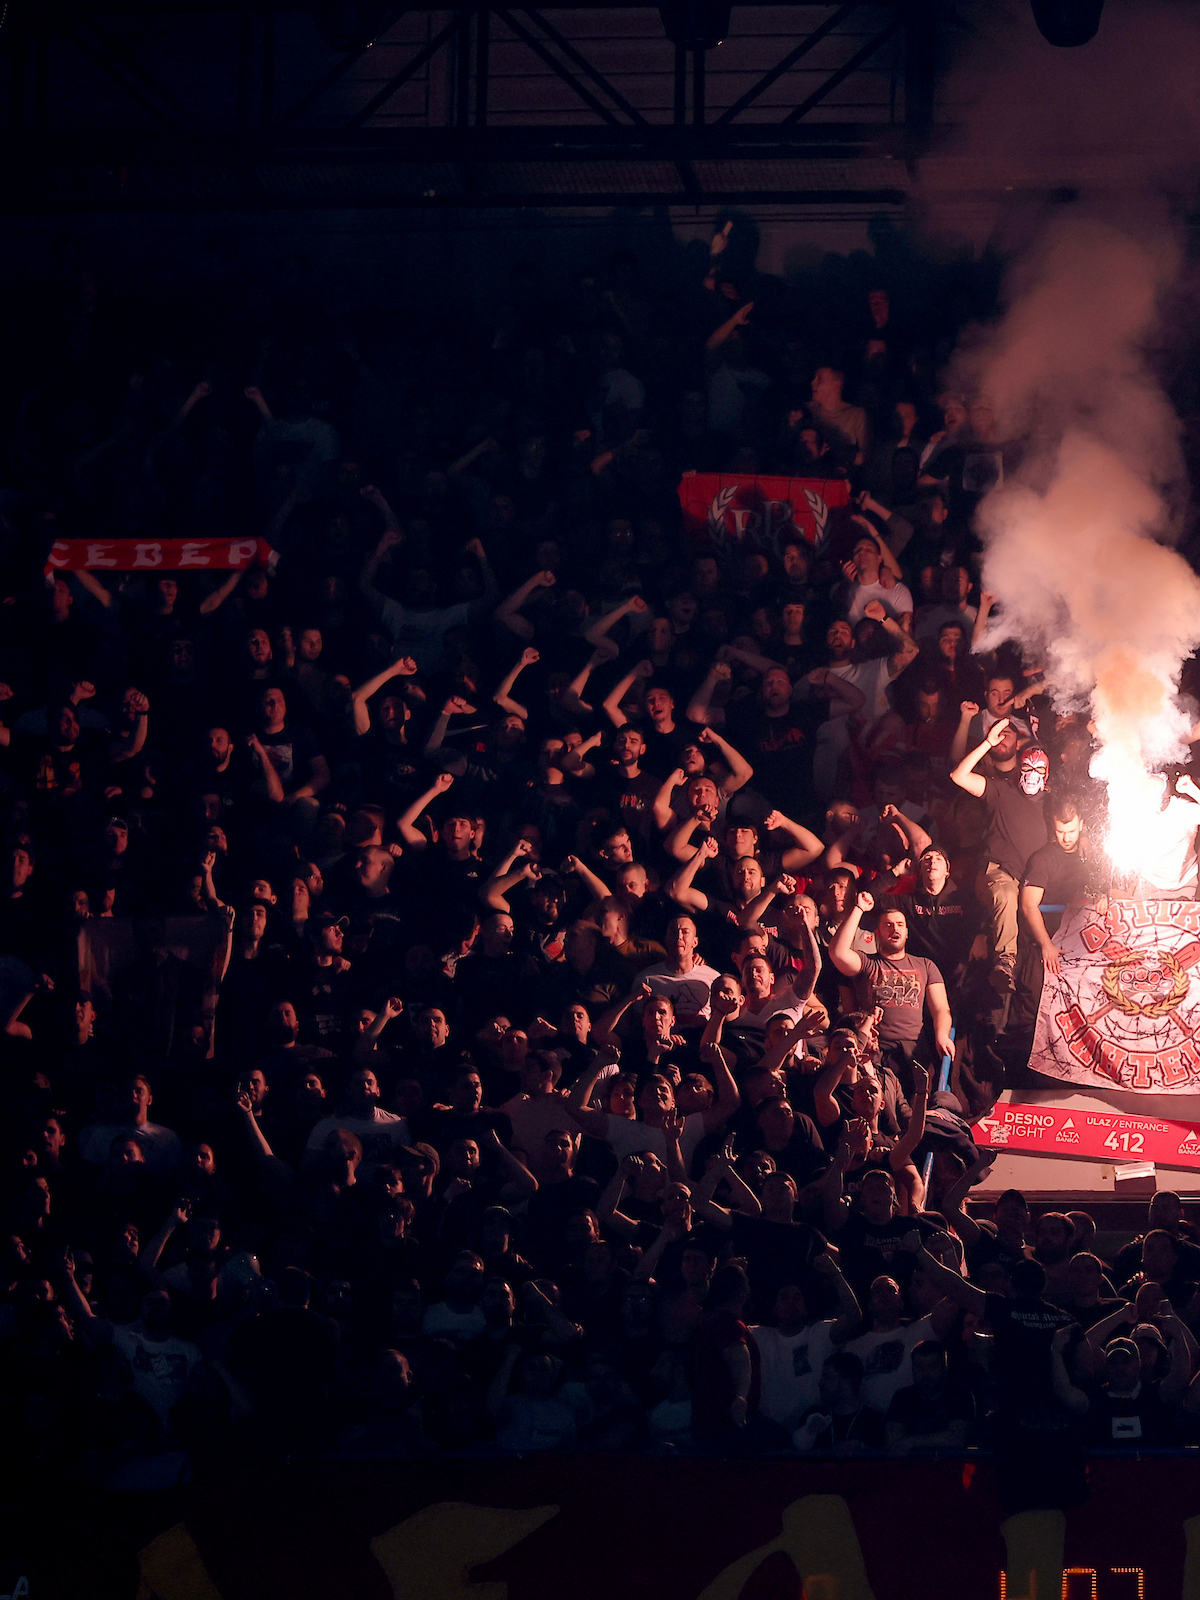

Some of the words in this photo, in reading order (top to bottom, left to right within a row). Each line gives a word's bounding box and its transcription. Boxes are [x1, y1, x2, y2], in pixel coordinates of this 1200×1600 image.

[49, 540, 258, 568] СЕВЕР
[1004, 1111, 1055, 1128] DESNO
[1087, 1117, 1111, 1127] ULAZ
[1119, 1120, 1169, 1133] ENTRANCE
[1005, 1124, 1046, 1139] RIGHT
[1103, 1130, 1145, 1153] 412
